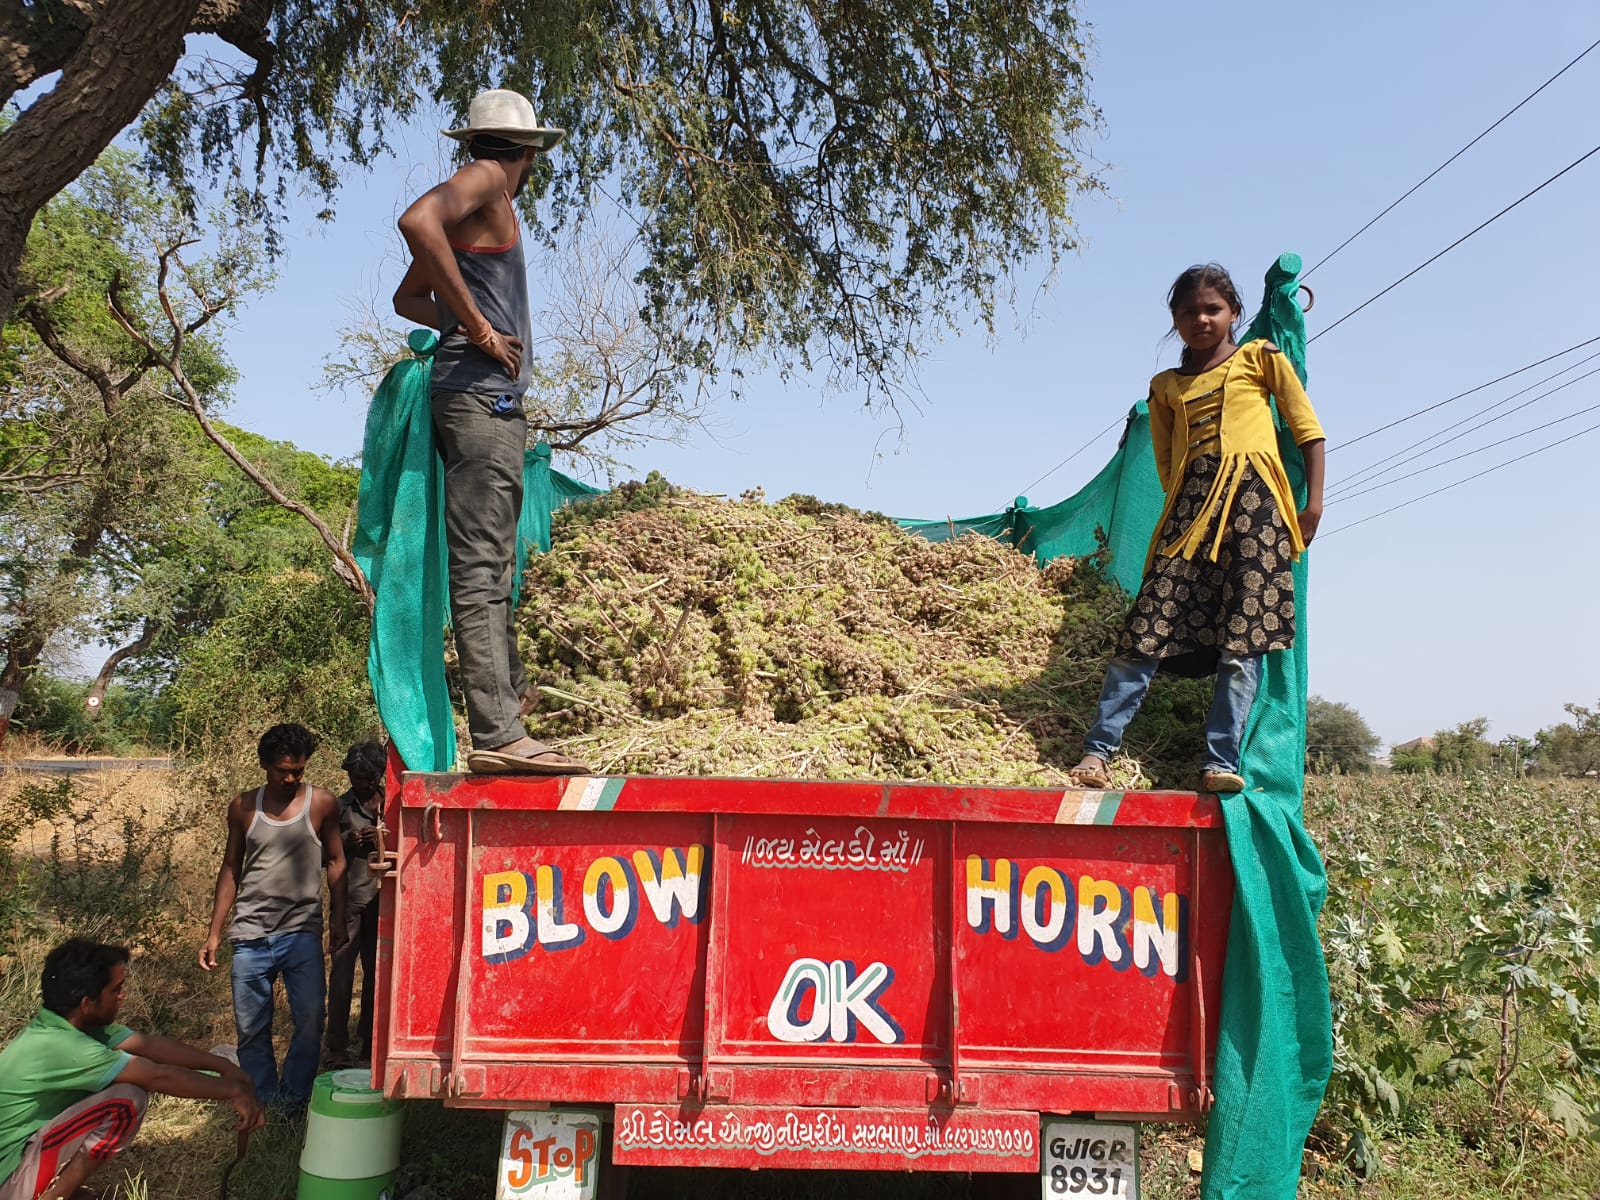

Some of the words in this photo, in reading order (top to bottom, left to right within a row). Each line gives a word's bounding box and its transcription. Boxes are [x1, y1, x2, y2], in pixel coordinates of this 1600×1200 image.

[482, 843, 708, 962] BLOW
[966, 854, 1186, 981] HORN
[767, 957, 902, 1045] OK
[1050, 1164, 1122, 1195] 8931
